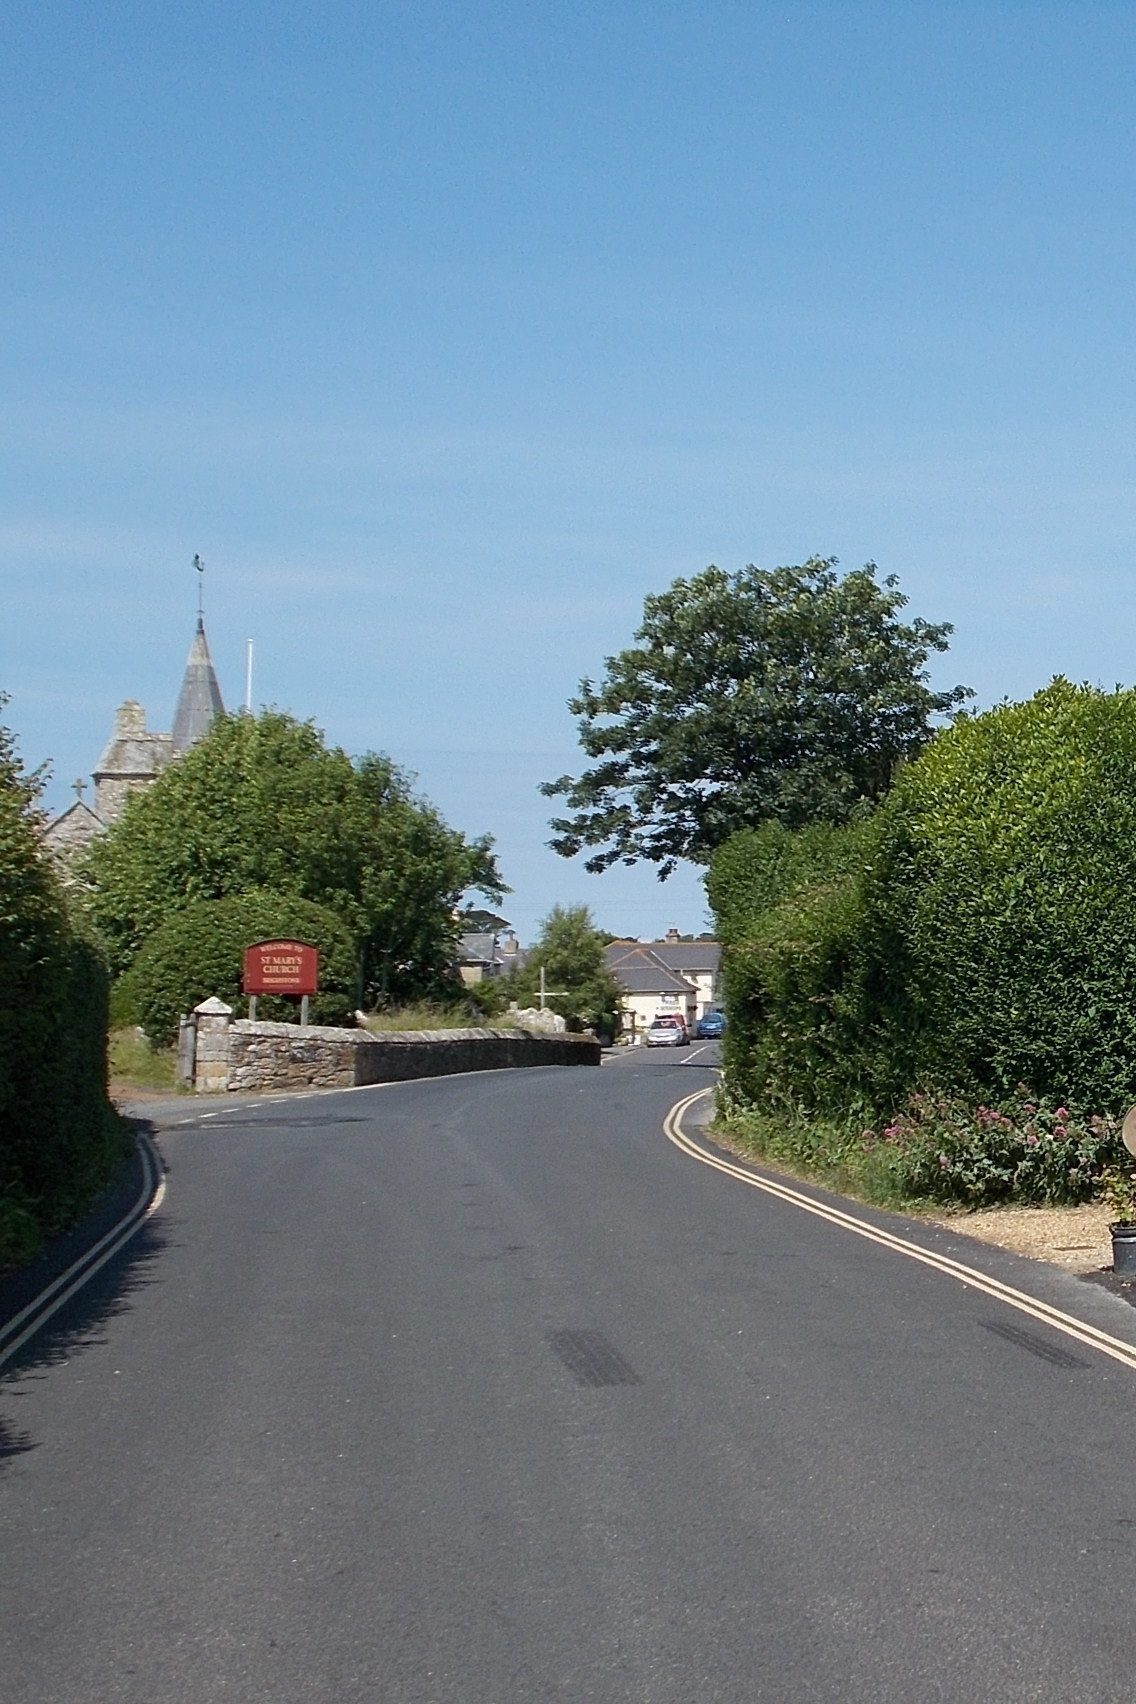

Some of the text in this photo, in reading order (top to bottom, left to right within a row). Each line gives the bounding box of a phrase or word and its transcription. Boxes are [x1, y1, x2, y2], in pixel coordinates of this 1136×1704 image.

[260, 944, 303, 953] WELCOME TO
[260, 956, 303, 964] ST MARY'S
[262, 965, 299, 973] CHURCH
